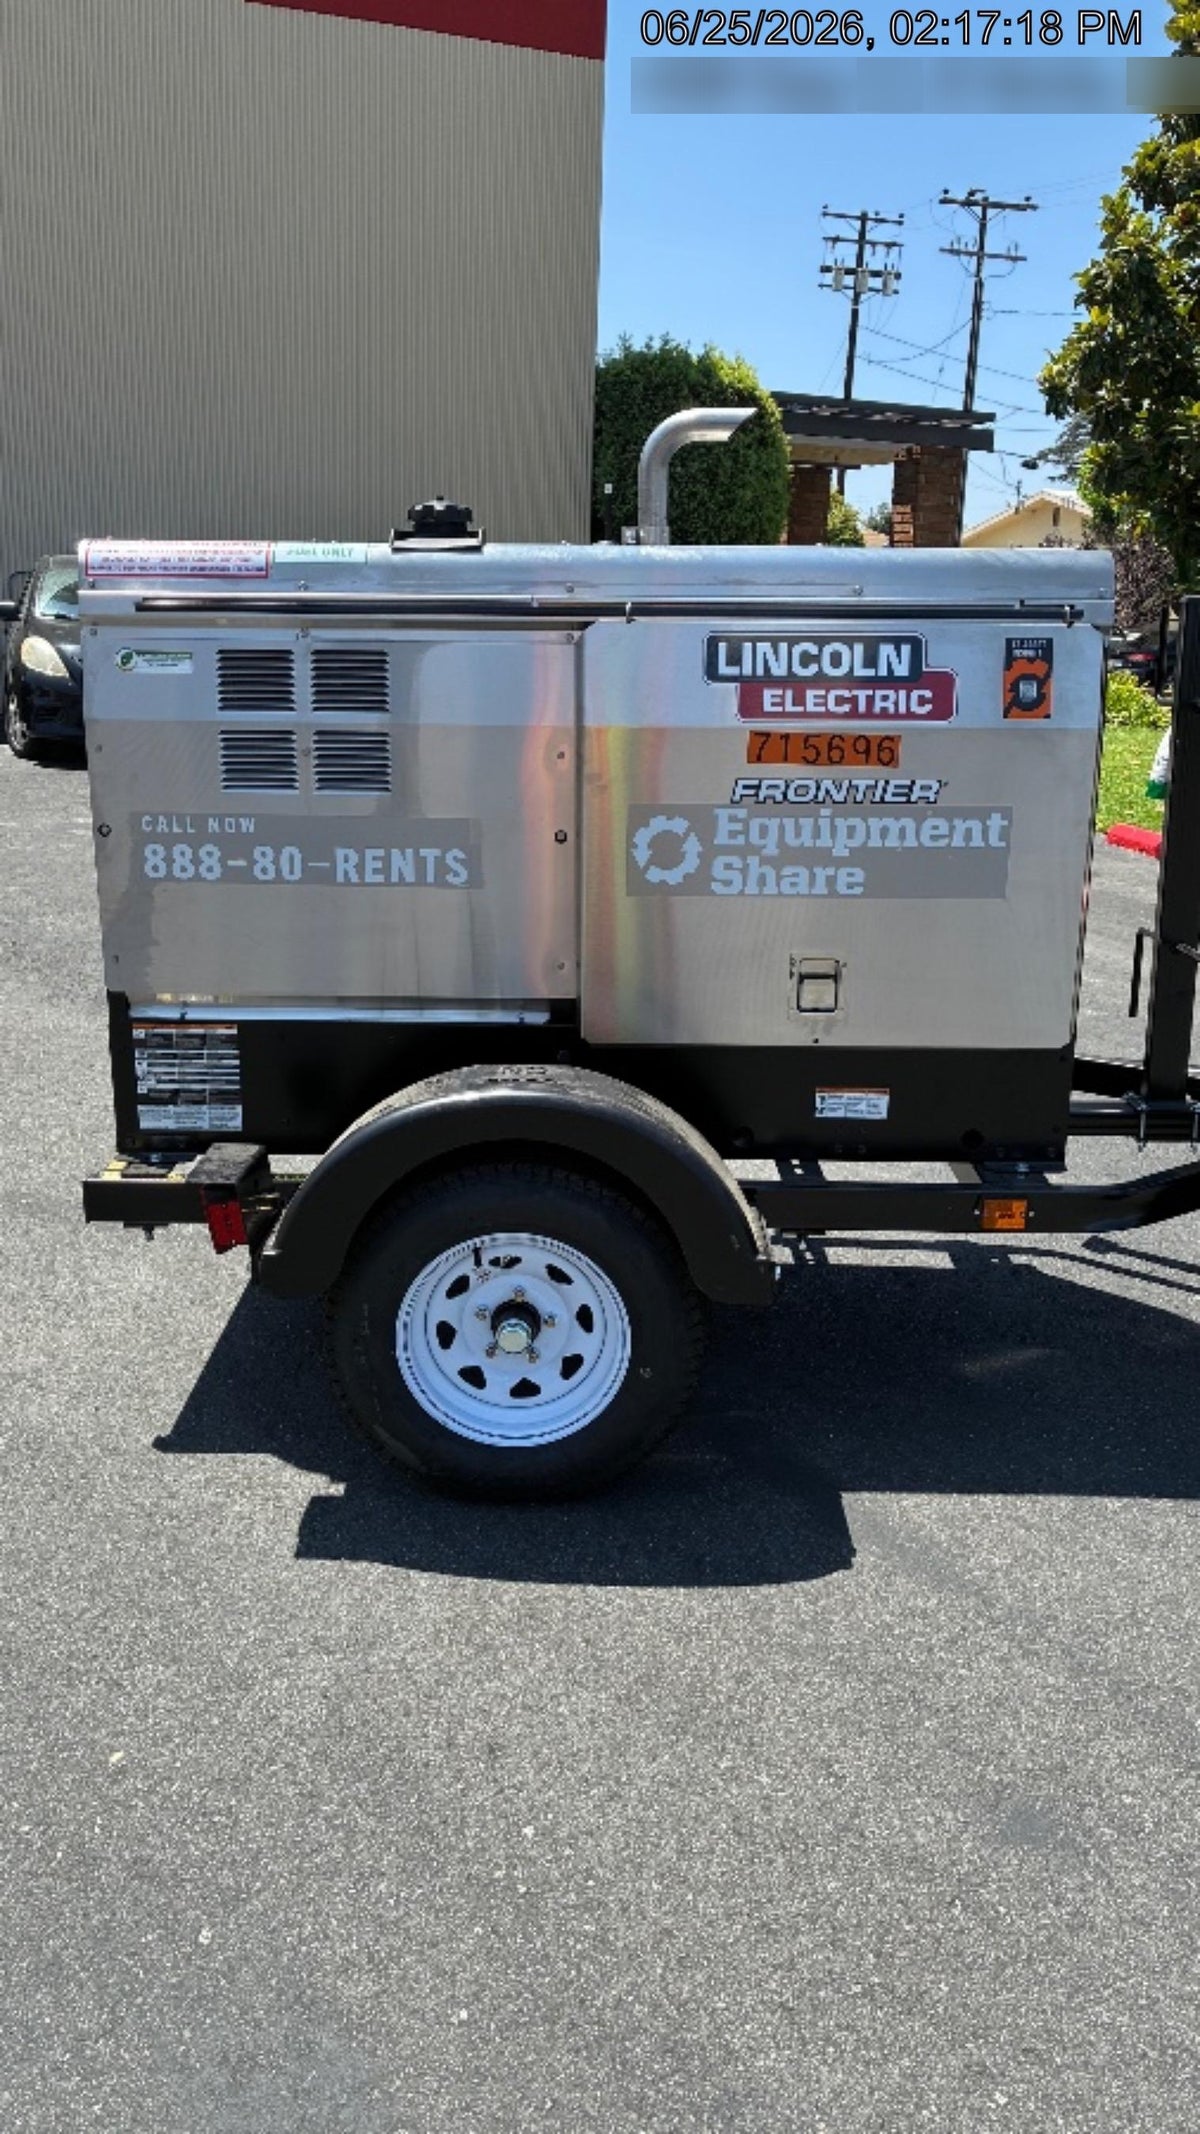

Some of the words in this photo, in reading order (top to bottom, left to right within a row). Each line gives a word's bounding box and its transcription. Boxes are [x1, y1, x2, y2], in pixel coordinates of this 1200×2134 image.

[717, 641, 911, 677] LINCOLN
[762, 688, 933, 714] ELECTRIC
[753, 732, 897, 767] 715696
[730, 778, 943, 804] FRONTIER
[141, 815, 196, 834] CALL
[207, 816, 256, 834] NOW
[712, 807, 1008, 857] Equipment
[143, 843, 470, 887] 888-80-RENTS
[710, 855, 865, 896] Share
